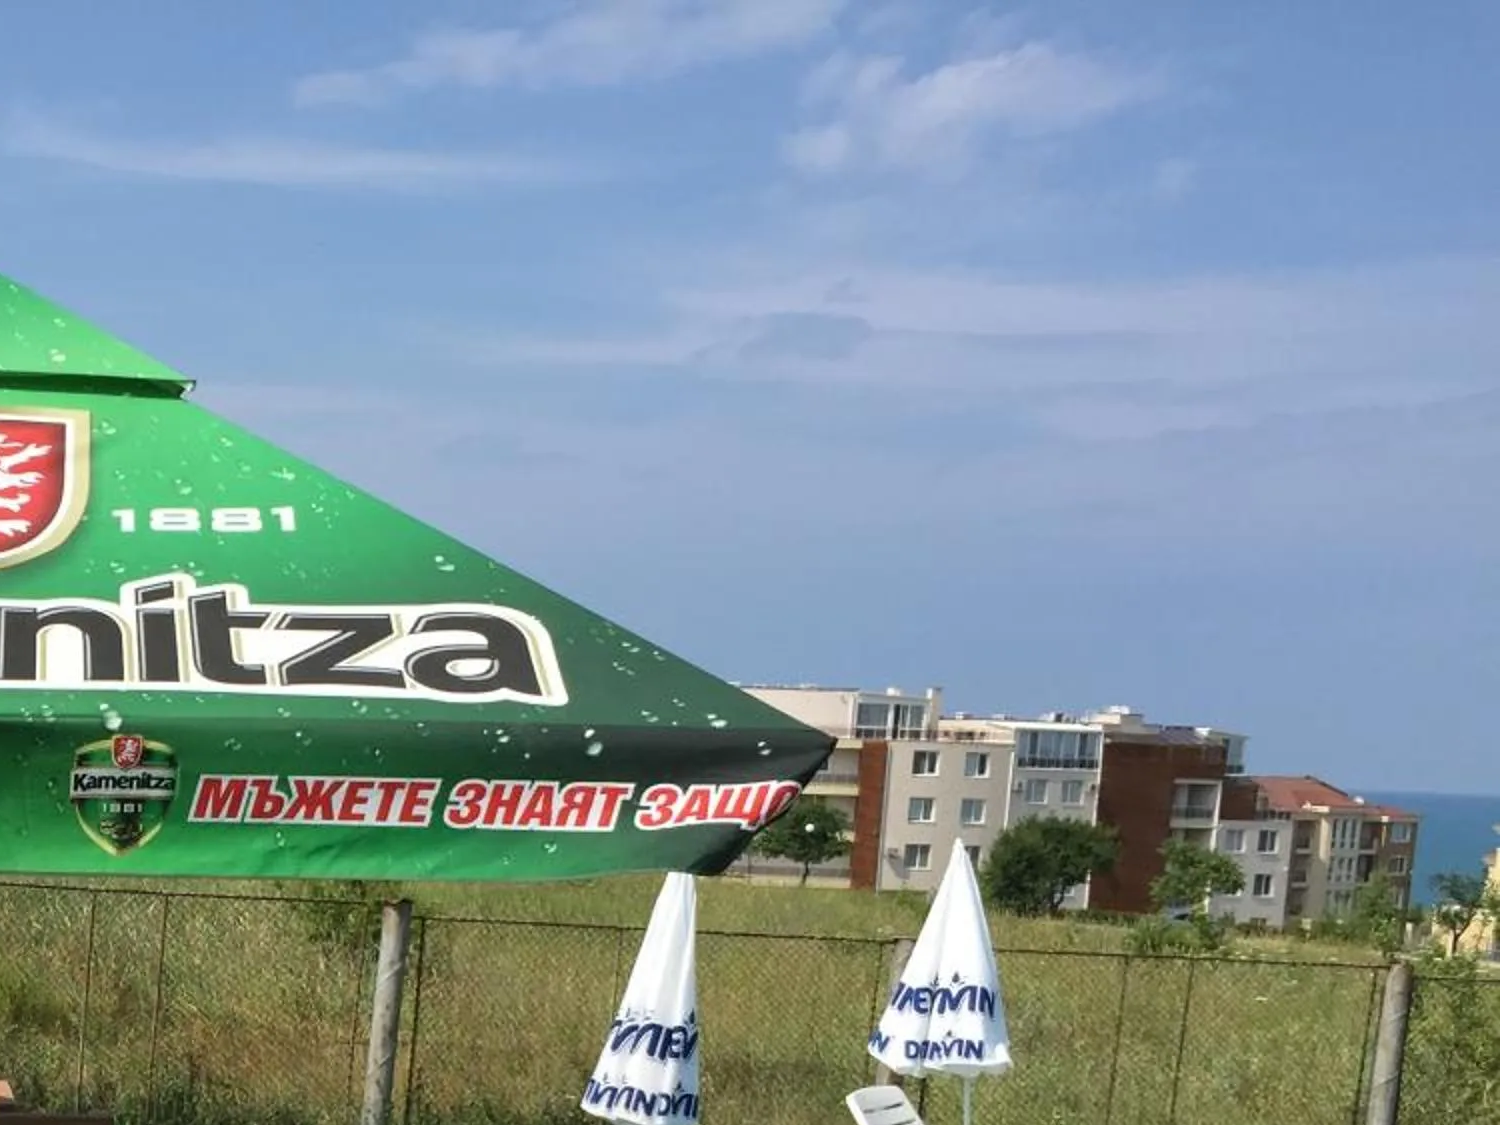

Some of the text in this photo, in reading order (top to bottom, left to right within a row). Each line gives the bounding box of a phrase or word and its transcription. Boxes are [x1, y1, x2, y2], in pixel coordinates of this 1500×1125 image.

[111, 505, 297, 533] 1881
[73, 771, 175, 792] Kamenitza
[192, 777, 438, 824] МЪЖЕТЕ
[445, 781, 630, 830] ЗНАЯТ
